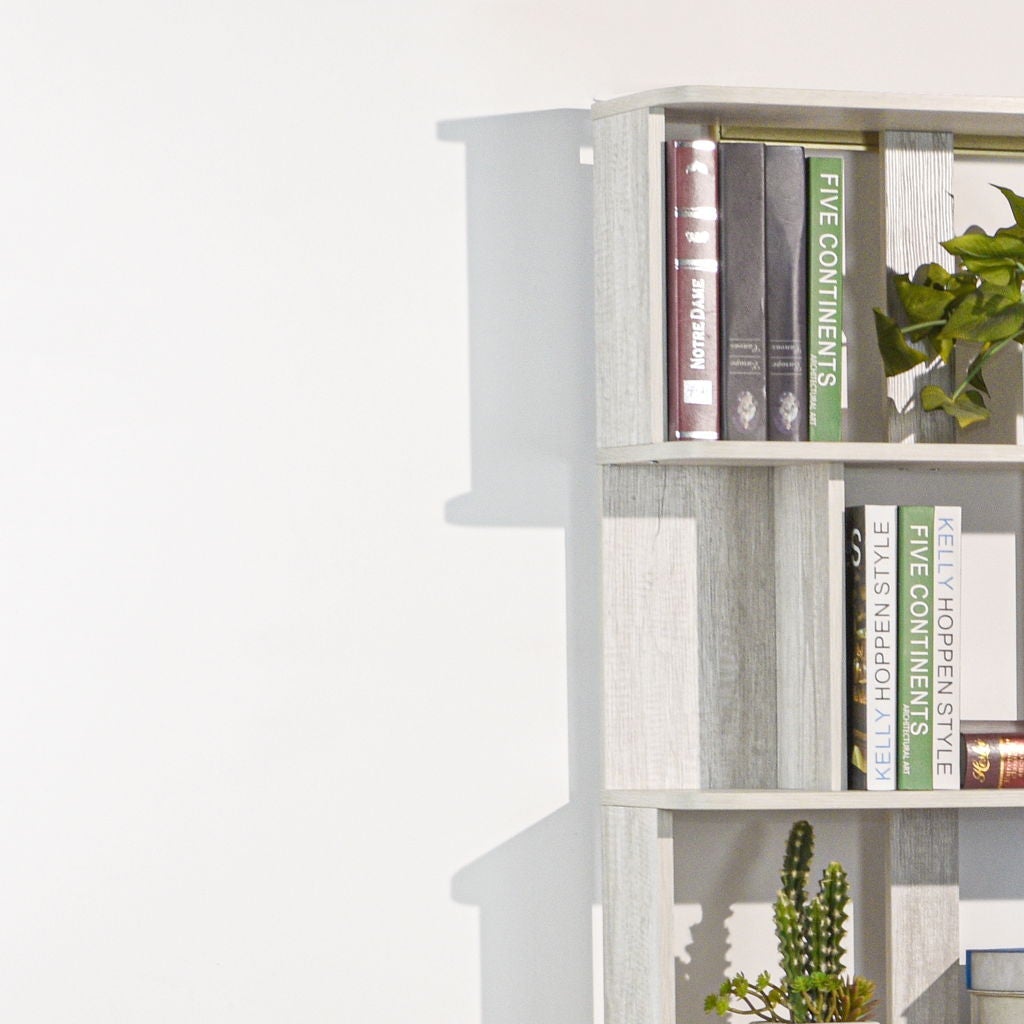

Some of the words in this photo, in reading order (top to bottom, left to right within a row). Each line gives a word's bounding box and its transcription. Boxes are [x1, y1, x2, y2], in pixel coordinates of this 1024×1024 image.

[820, 173, 839, 227] FIVE
[690, 278, 705, 320] DAME
[818, 233, 839, 386] CONTINENTS
[809, 411, 817, 426] ART
[873, 521, 890, 595] STYLE
[910, 525, 929, 577] FIVE
[938, 517, 954, 591] KELLY
[874, 602, 891, 701] HOPPEN
[909, 584, 929, 736] CONTINENTS
[937, 597, 954, 694] HOPPEN
[875, 708, 891, 780] KELLY
[902, 704, 911, 758] ARCHITECTURAL
[902, 758, 910, 775] ART
[937, 702, 953, 776] STYLE
